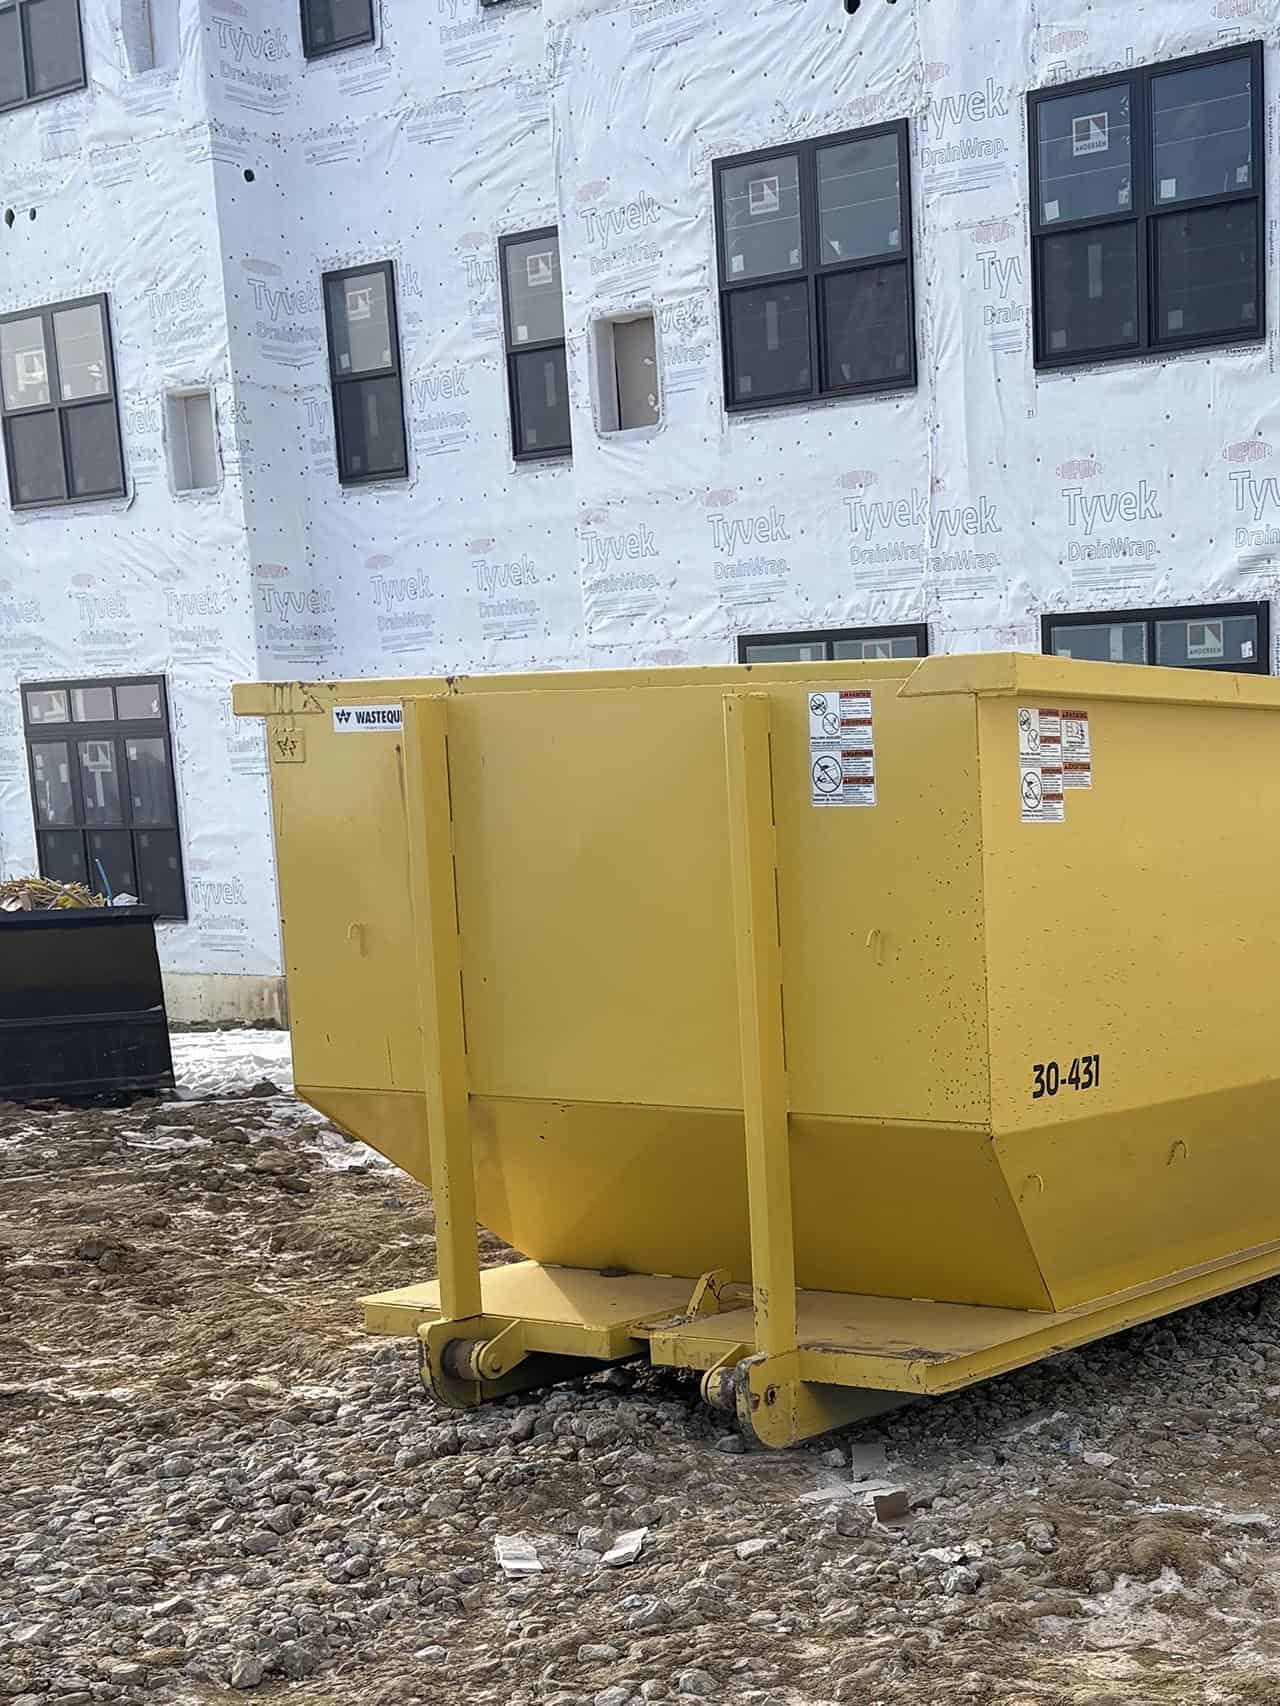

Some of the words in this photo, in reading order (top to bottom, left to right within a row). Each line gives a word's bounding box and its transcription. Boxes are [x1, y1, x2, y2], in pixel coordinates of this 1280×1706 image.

[211, 16, 290, 62] Tyvek
[581, 190, 660, 248] Tyvek
[248, 280, 320, 322] Tyvek
[708, 505, 788, 555] Tyvek
[843, 488, 928, 540] Tyvek
[1062, 480, 1160, 535] Tyvek
[581, 522, 658, 570] Tyvek
[370, 568, 433, 613] Tyvek
[471, 554, 538, 597] Tyvek
[190, 878, 247, 912] Tyvek
[1032, 1054, 1099, 1098] 30-431
